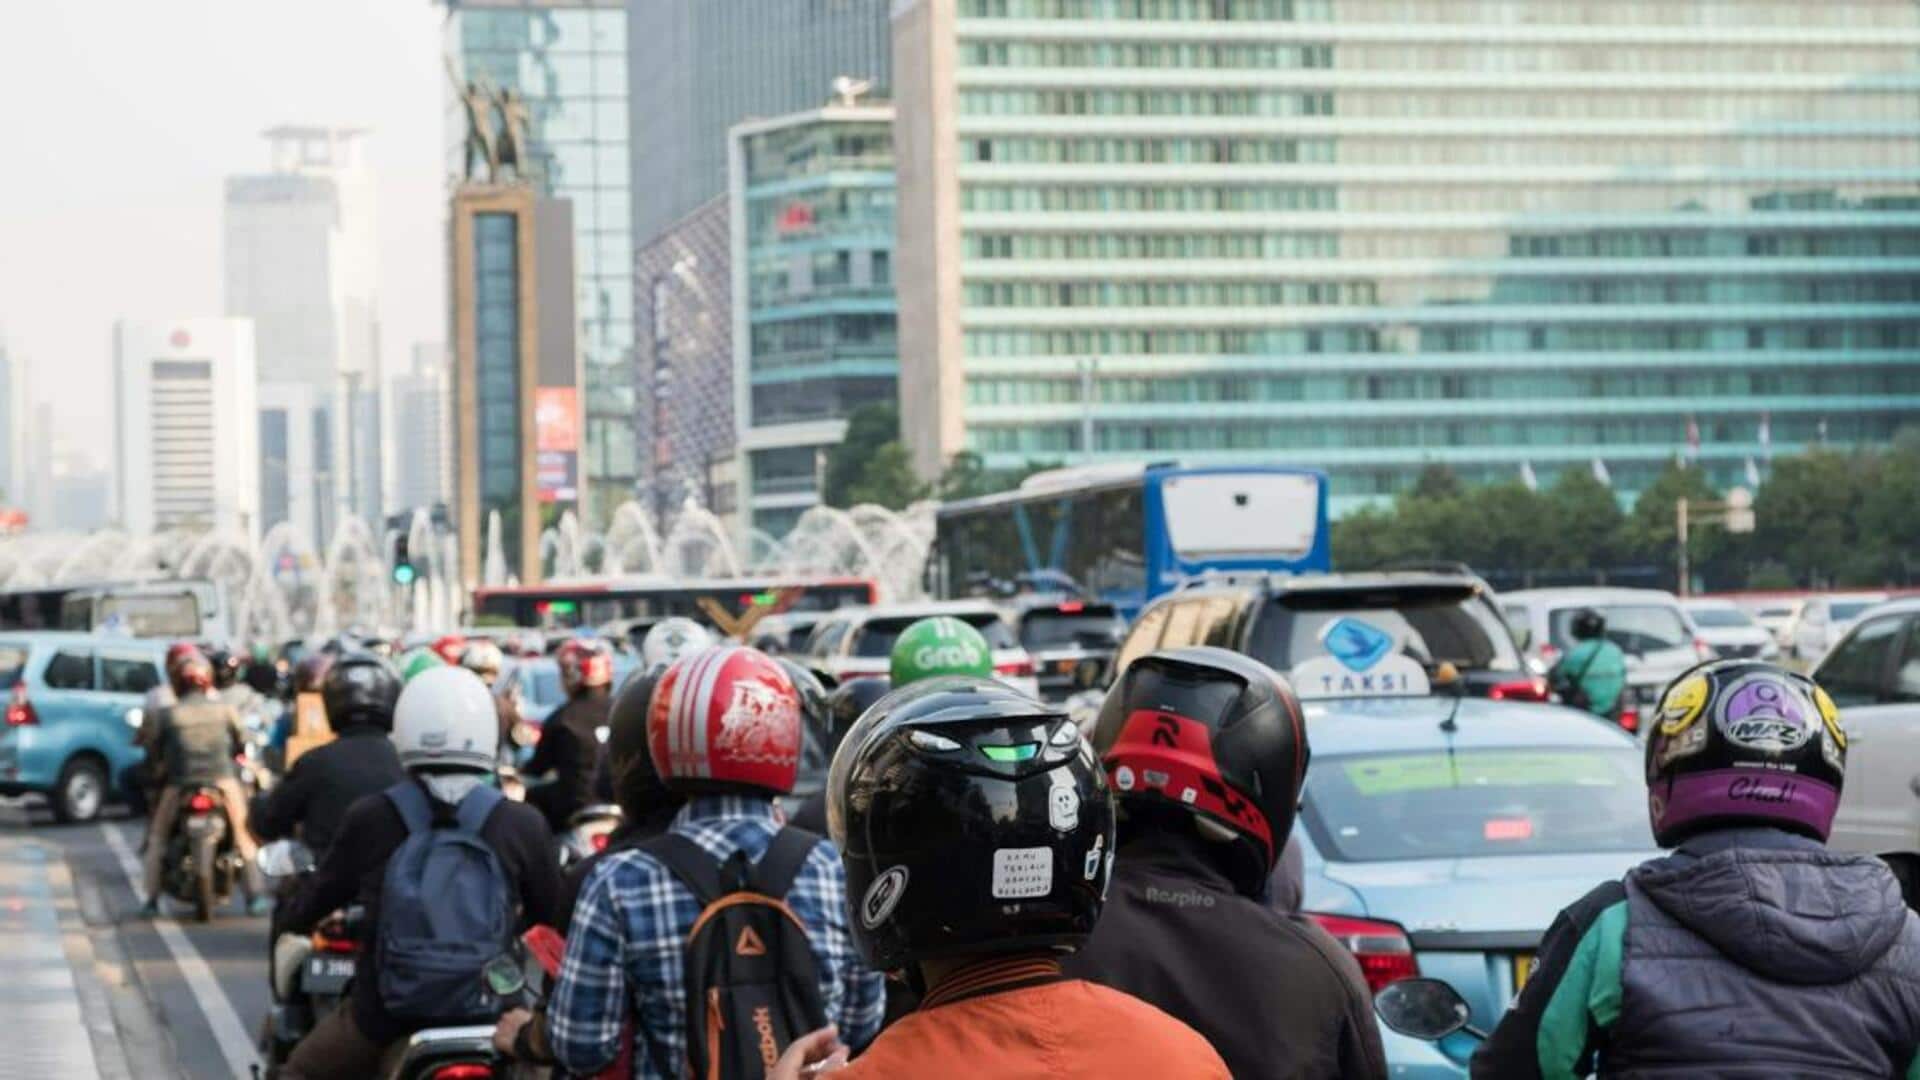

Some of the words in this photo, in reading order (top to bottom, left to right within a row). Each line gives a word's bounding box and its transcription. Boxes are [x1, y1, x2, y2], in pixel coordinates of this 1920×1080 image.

[914, 640, 981, 670] Grab
[1321, 674, 1407, 690] TAKSI
[1145, 887, 1216, 908] Respiro
